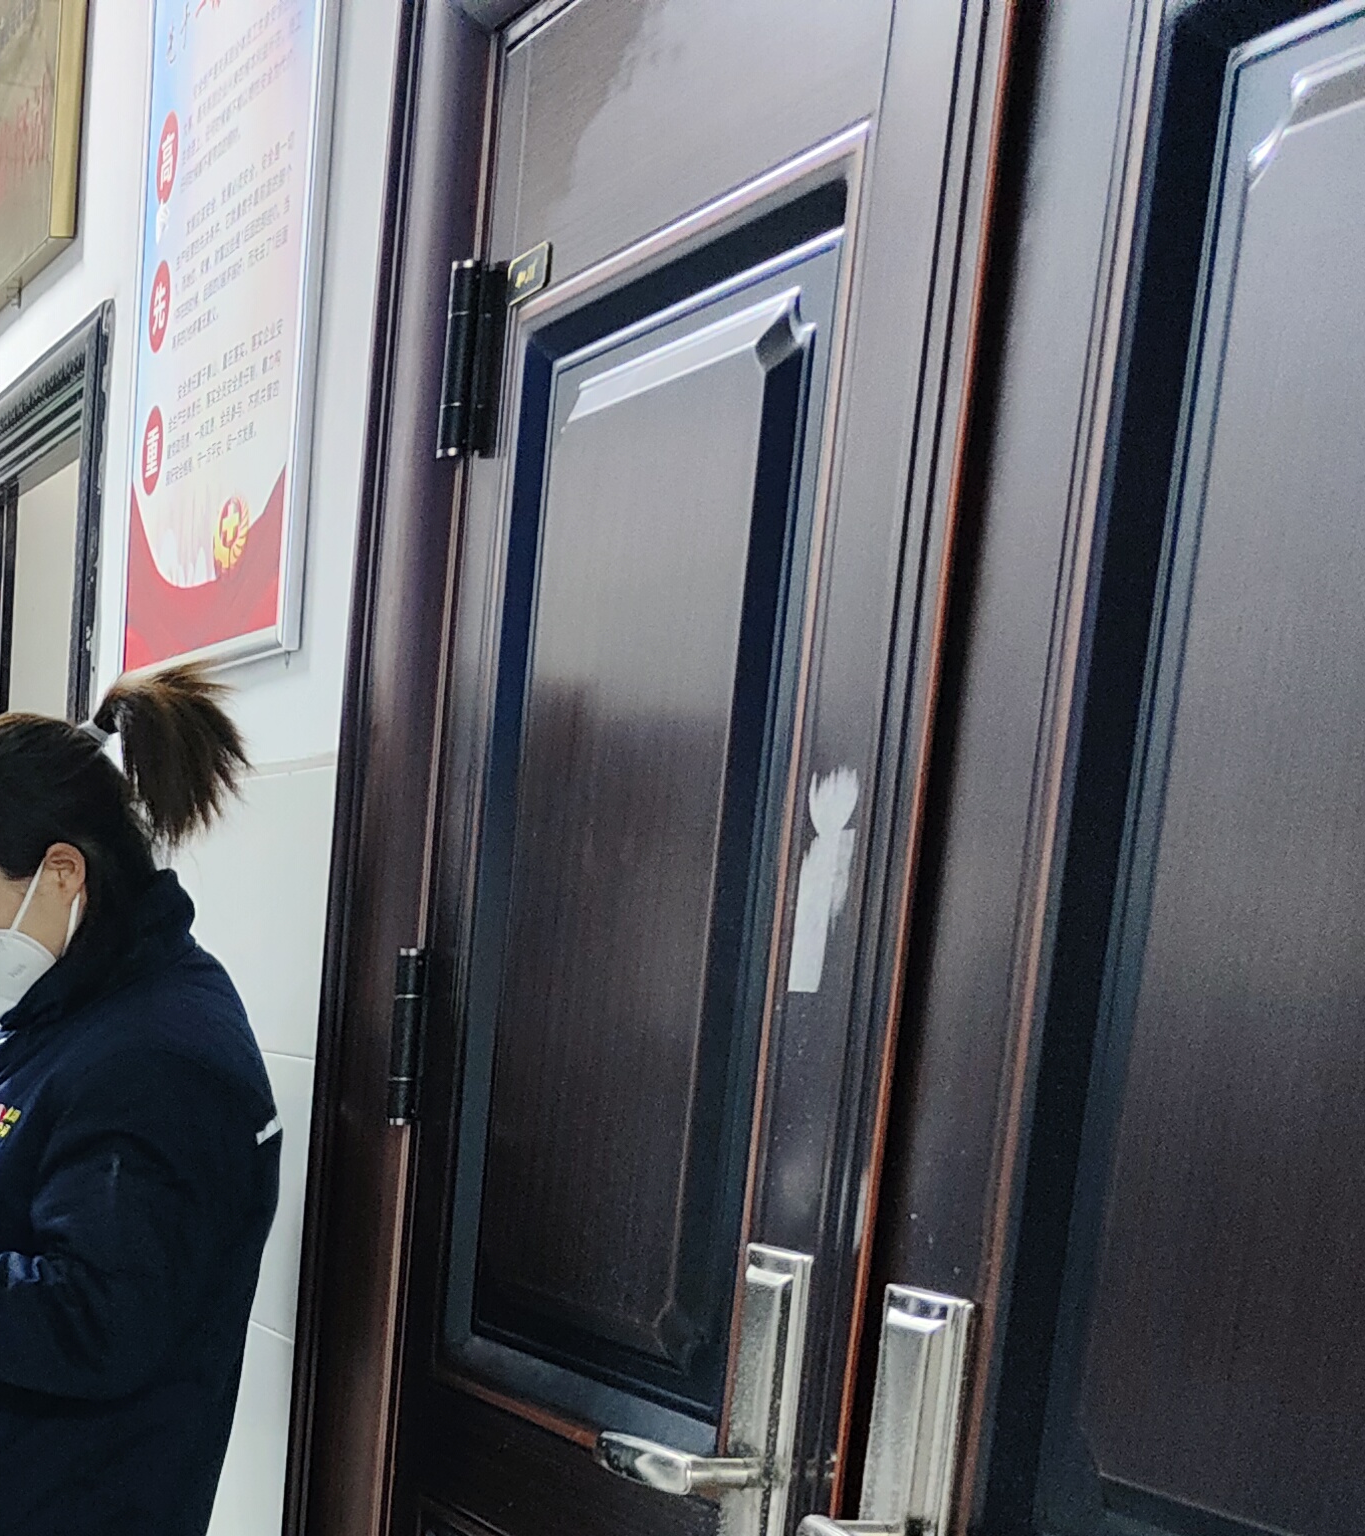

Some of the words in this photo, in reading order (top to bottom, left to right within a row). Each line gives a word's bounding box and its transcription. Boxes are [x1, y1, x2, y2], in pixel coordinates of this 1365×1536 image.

[159, 131, 176, 191] 高
[152, 281, 167, 336] 先
[144, 425, 160, 479] 重
